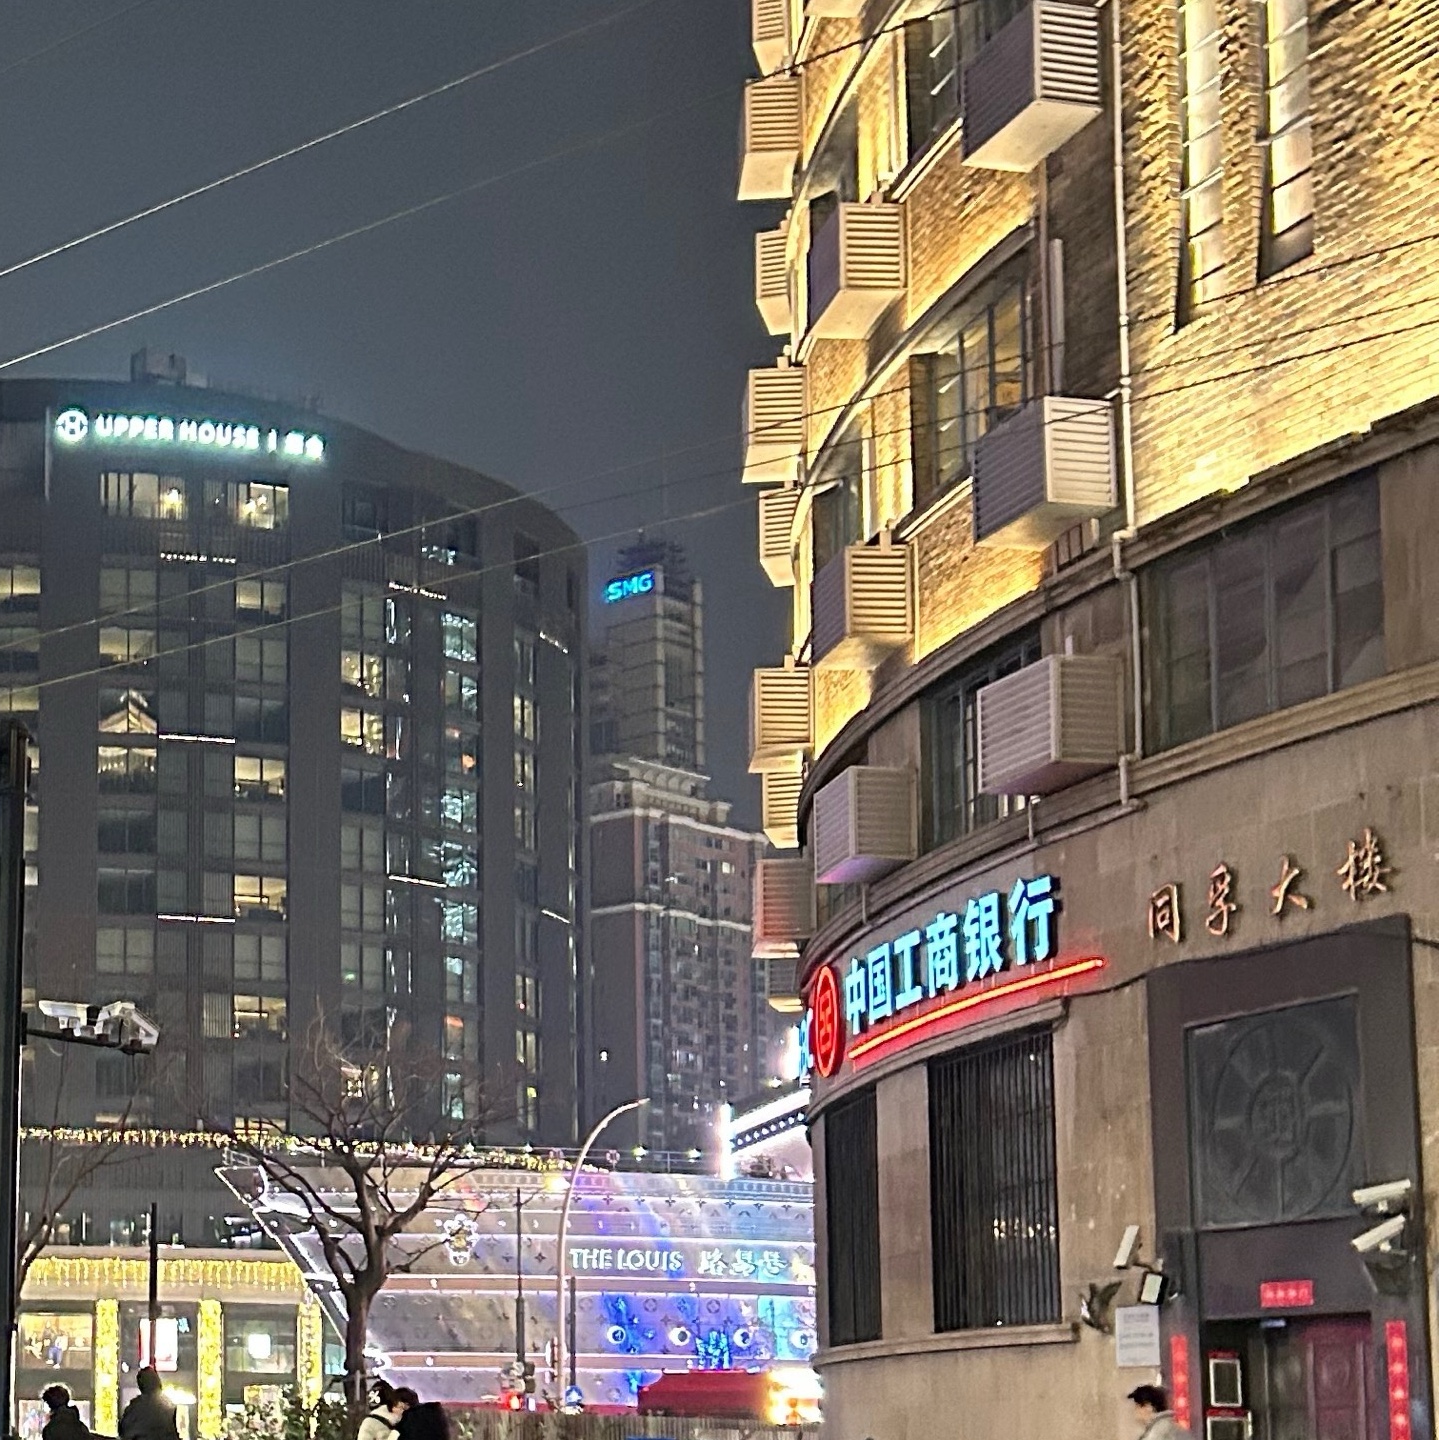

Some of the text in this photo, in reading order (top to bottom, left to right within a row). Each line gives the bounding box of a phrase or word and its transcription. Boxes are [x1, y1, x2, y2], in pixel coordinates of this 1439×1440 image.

[95, 413, 174, 441] UPPER
[179, 418, 260, 450] HOUSE
[607, 573, 653, 601] SMG
[1148, 827, 1391, 943] 同孚大楼
[845, 876, 1054, 1034] 中国工商银行
[569, 1248, 684, 1272] THE LOUIS
[697, 1247, 788, 1276] 路易号
